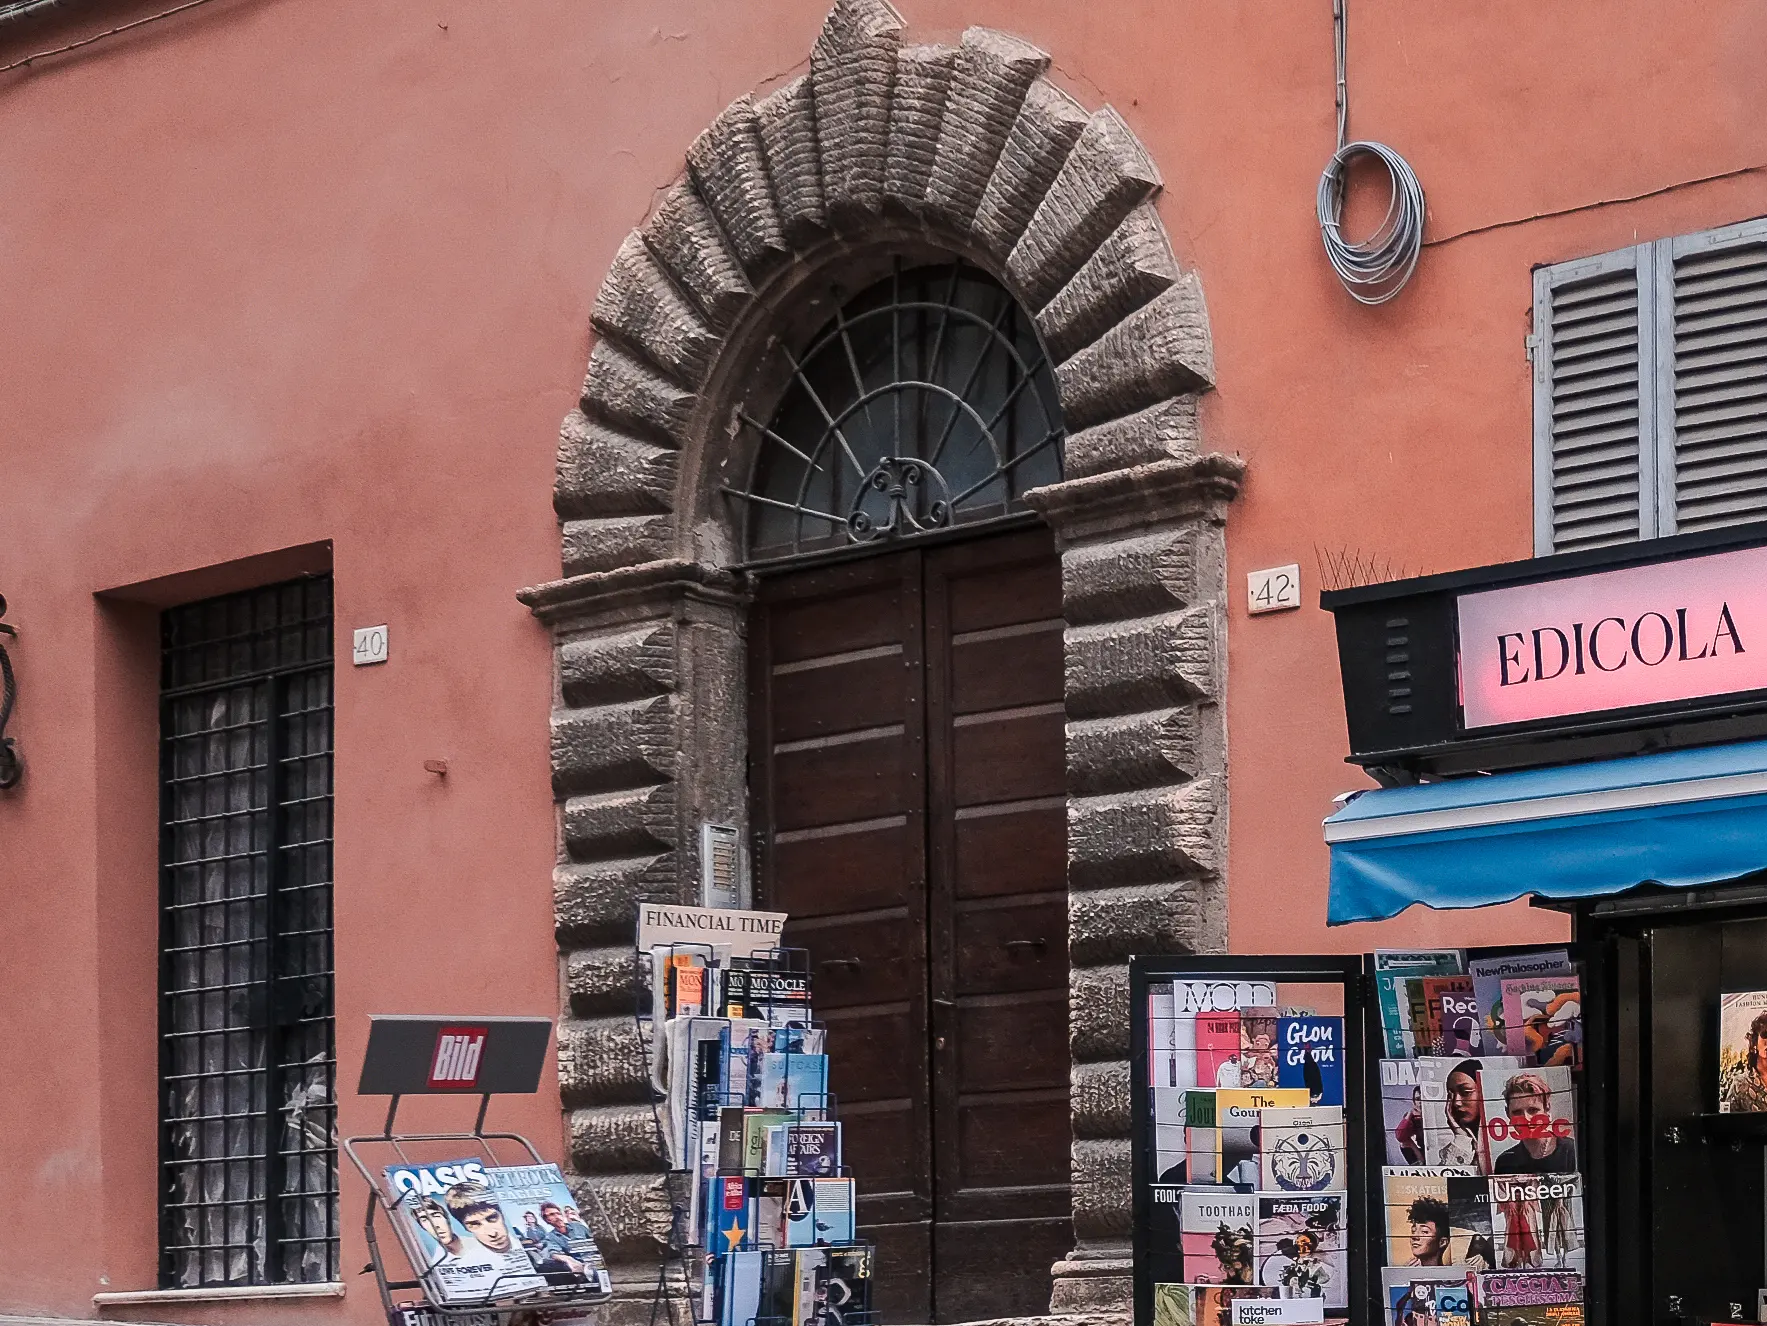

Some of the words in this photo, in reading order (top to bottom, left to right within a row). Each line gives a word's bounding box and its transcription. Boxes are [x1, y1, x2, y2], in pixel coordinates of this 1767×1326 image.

[1255, 574, 1290, 605] 42
[357, 632, 382, 657] 40
[1497, 602, 1745, 687] EDICOLA
[646, 910, 734, 931] FINANCIAL
[432, 1036, 484, 1081] Bild
[1251, 1096, 1275, 1108] The
[394, 1163, 490, 1198] OASIS
[1494, 1181, 1576, 1204] Unseen
[1239, 1305, 1282, 1316] kitchen
[1239, 1315, 1265, 1325] toke
